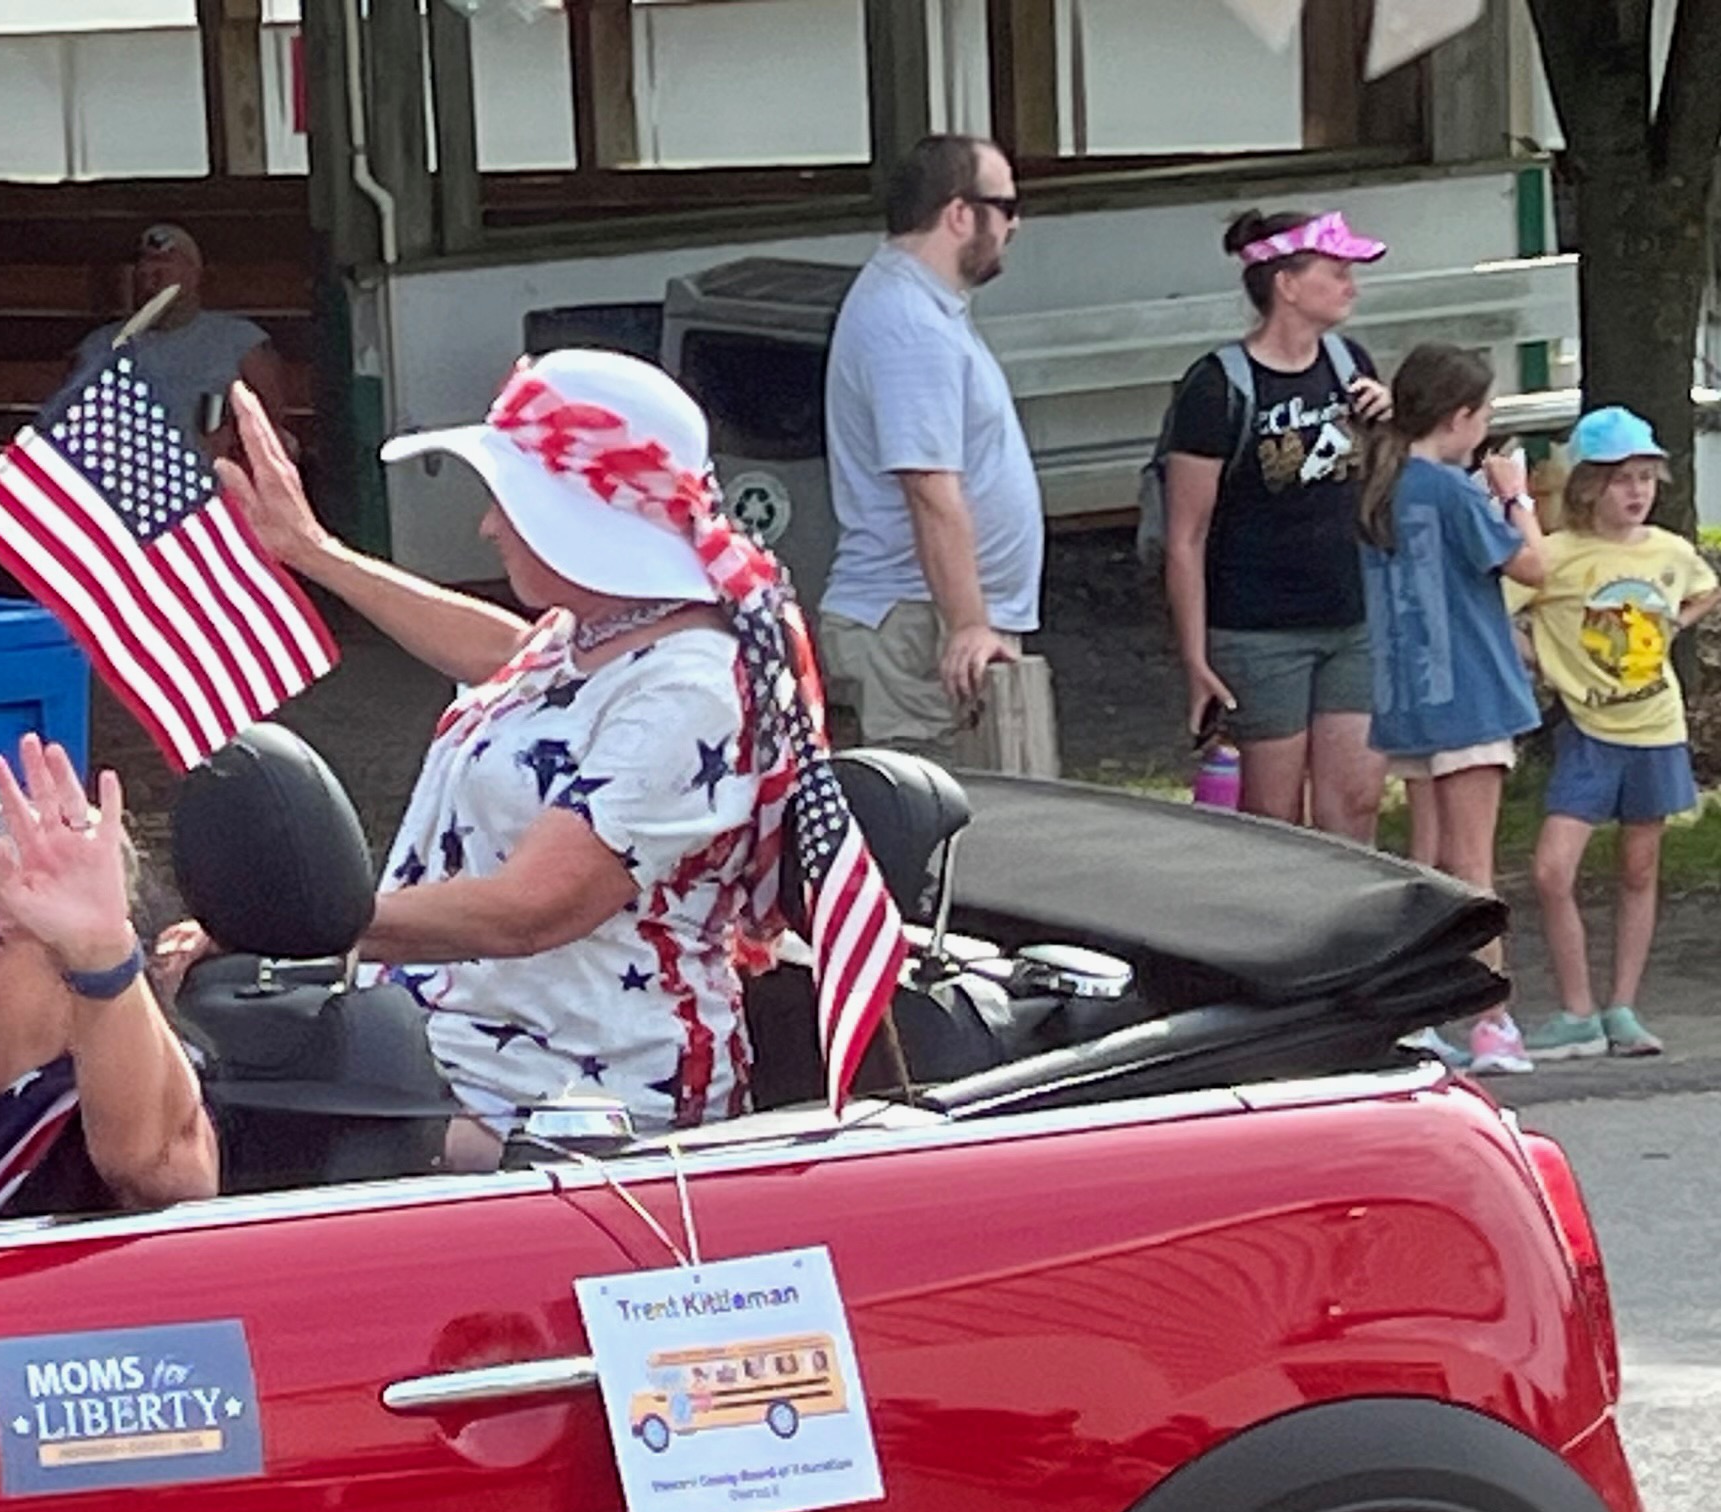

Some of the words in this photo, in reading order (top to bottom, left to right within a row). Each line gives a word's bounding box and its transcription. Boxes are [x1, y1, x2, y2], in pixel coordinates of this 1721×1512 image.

[617, 1294, 680, 1320] Trent
[26, 1356, 145, 1397] MOMS
[151, 1354, 194, 1389] for
[34, 1387, 221, 1440] LIBERTY
